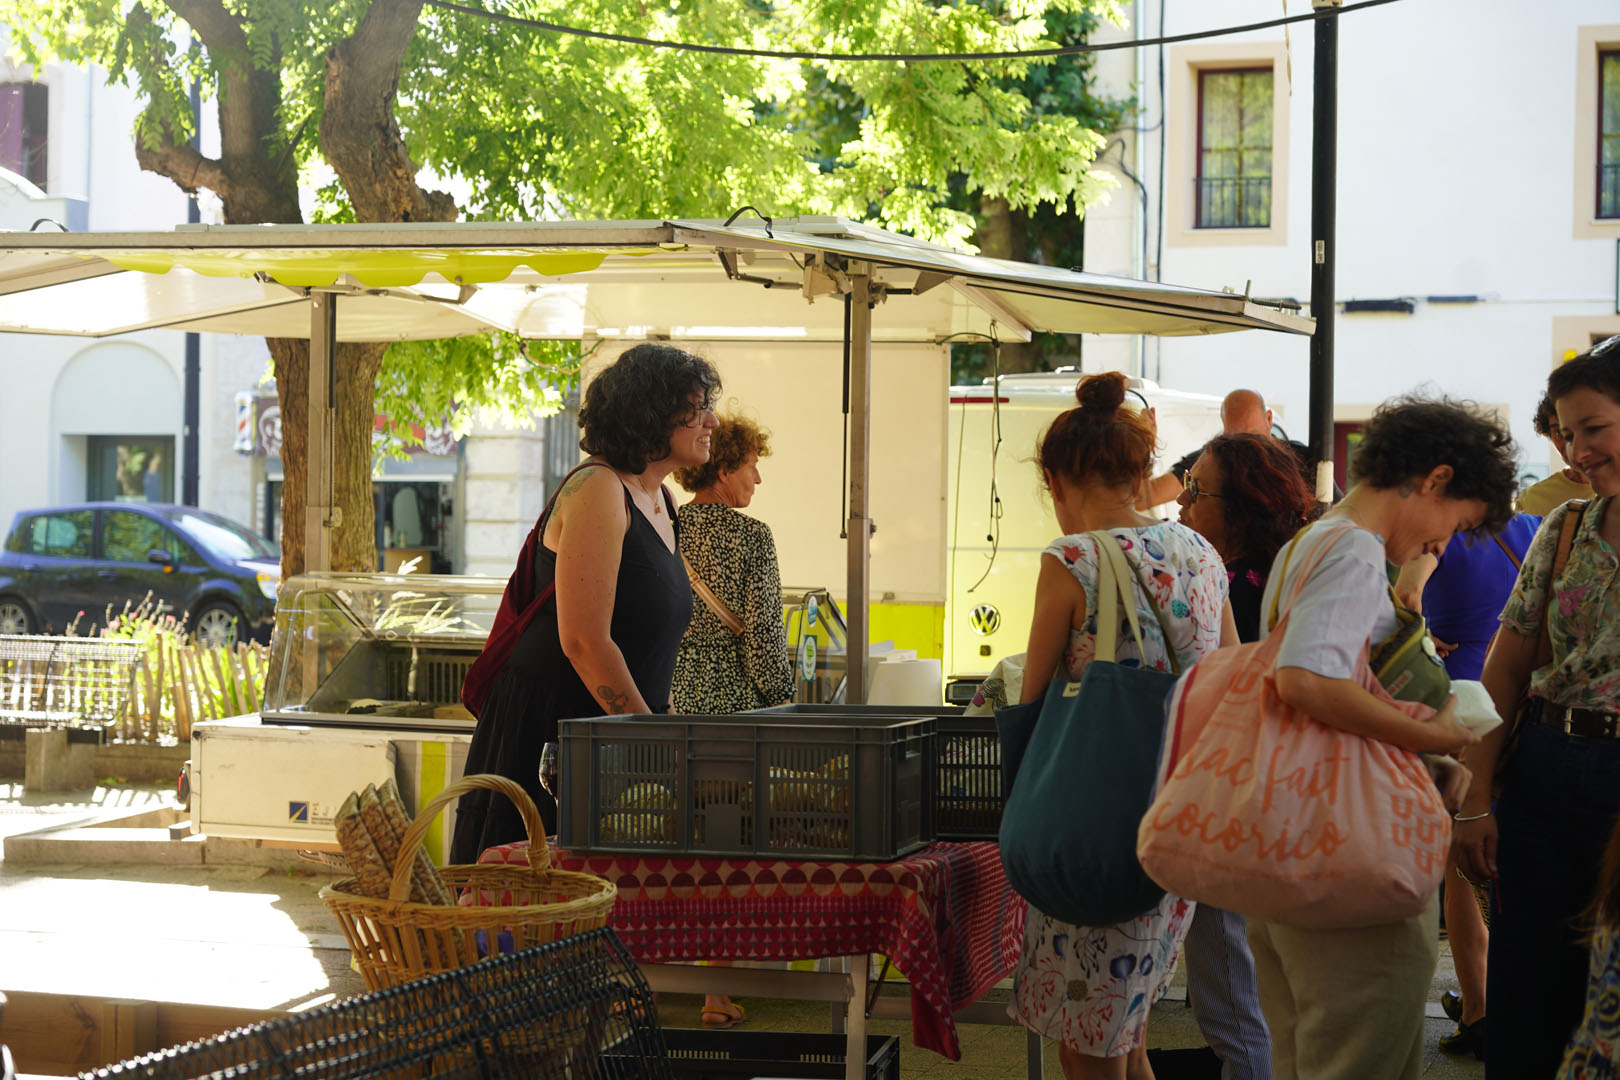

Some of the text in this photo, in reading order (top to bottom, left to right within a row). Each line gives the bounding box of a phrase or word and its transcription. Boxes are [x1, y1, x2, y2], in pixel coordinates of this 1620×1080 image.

[1174, 742, 1352, 815] sac fait
[1150, 800, 1348, 862] cocorico
